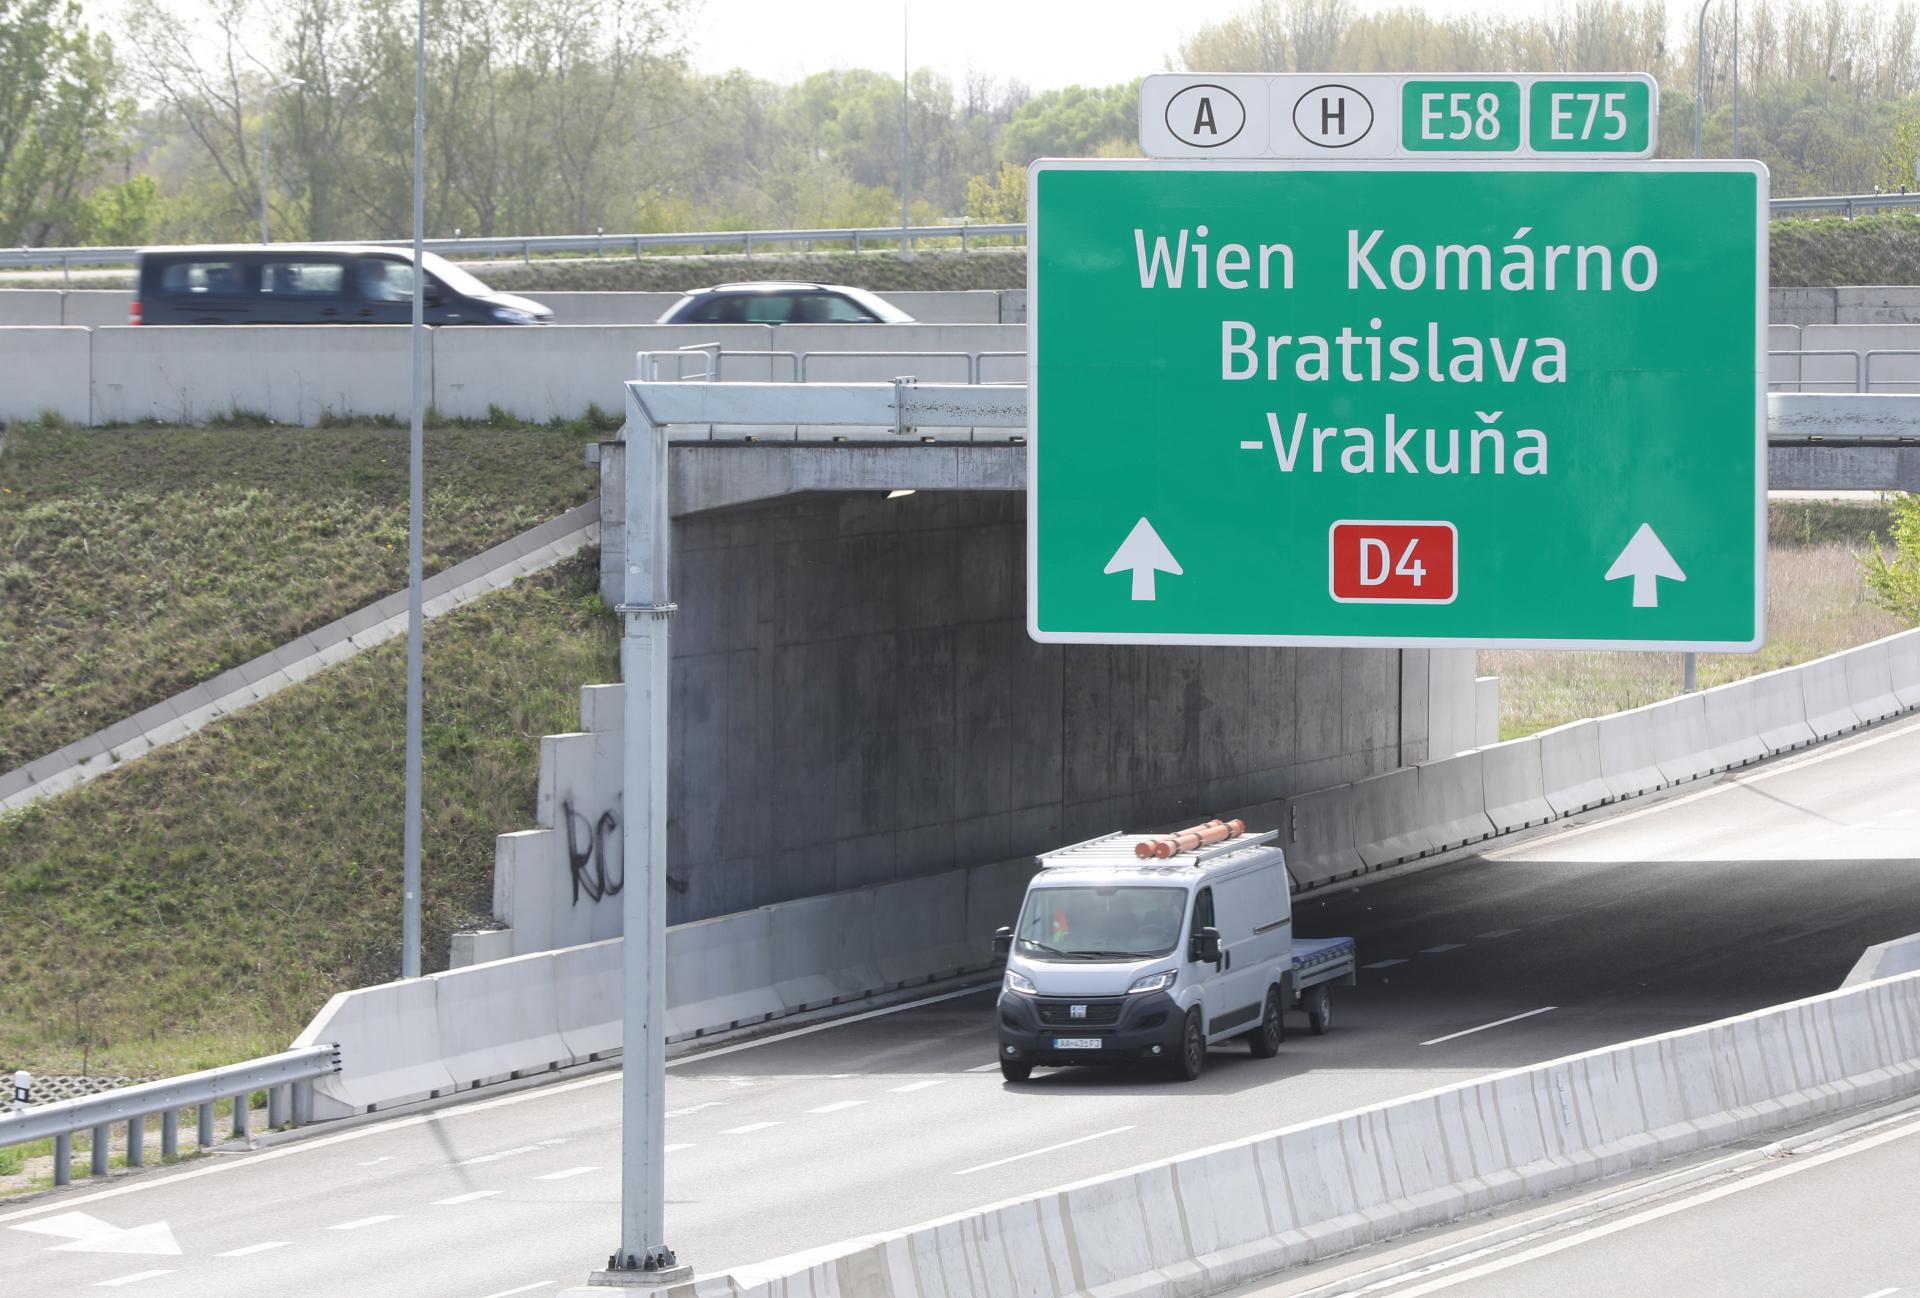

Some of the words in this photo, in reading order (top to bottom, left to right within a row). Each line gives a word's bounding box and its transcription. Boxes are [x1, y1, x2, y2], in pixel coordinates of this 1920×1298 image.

[1192, 97, 1218, 135] A
[1320, 97, 1346, 135] H
[1421, 92, 1501, 140] E58
[1550, 92, 1628, 141] E75
[1134, 225, 1295, 290] Wien
[1347, 226, 1659, 292] Komárno
[1221, 317, 1567, 383] Bratislava
[1239, 410, 1548, 475] -Vrakuňa
[1359, 537, 1428, 587] D4
